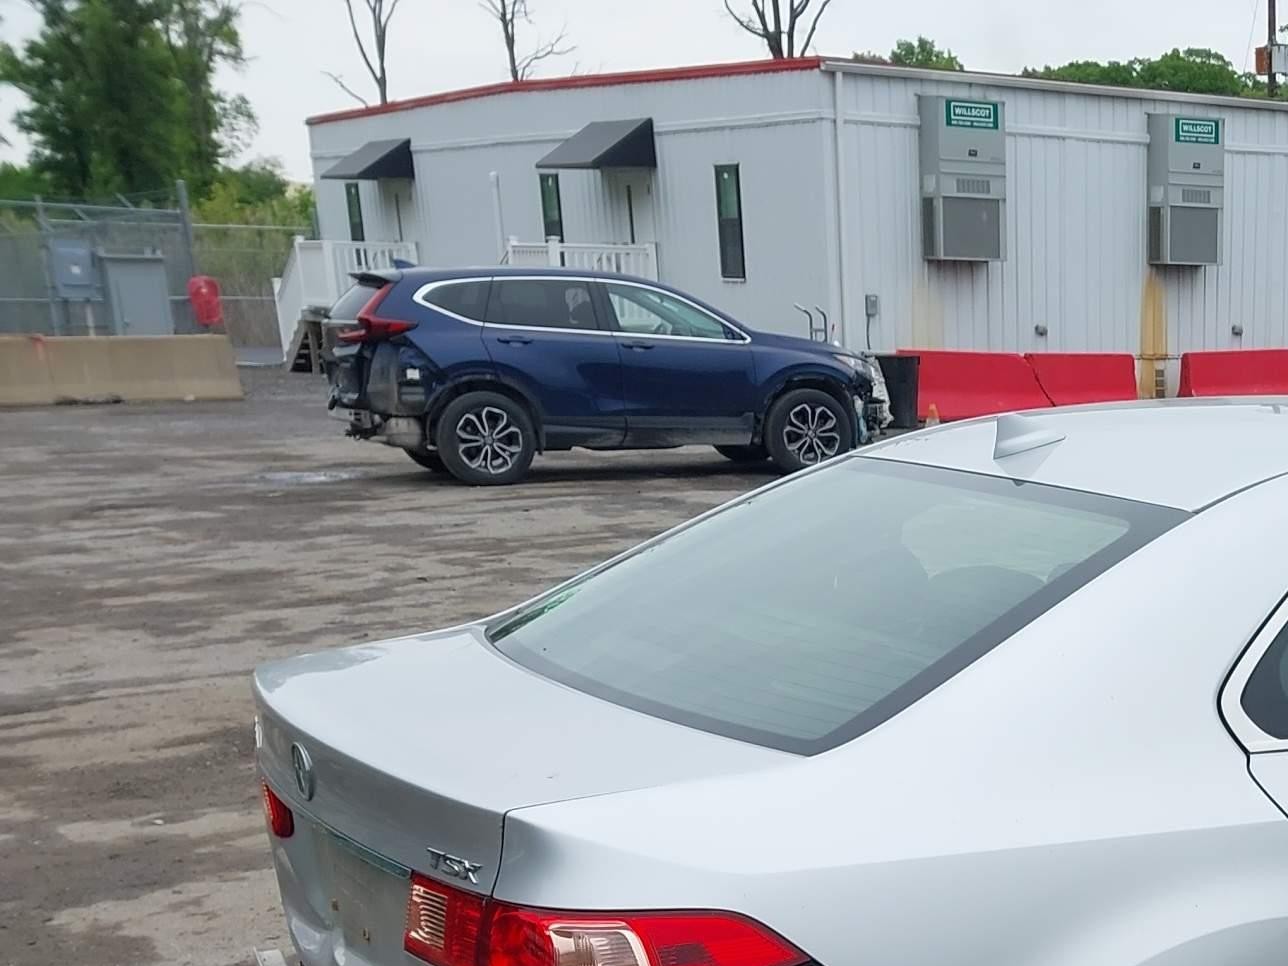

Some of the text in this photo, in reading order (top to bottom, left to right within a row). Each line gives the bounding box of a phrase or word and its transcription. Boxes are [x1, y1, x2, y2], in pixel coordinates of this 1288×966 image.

[954, 106, 990, 117] WILLSCOT
[1182, 124, 1212, 133] WILLSCOT
[426, 847, 483, 885] TSX
